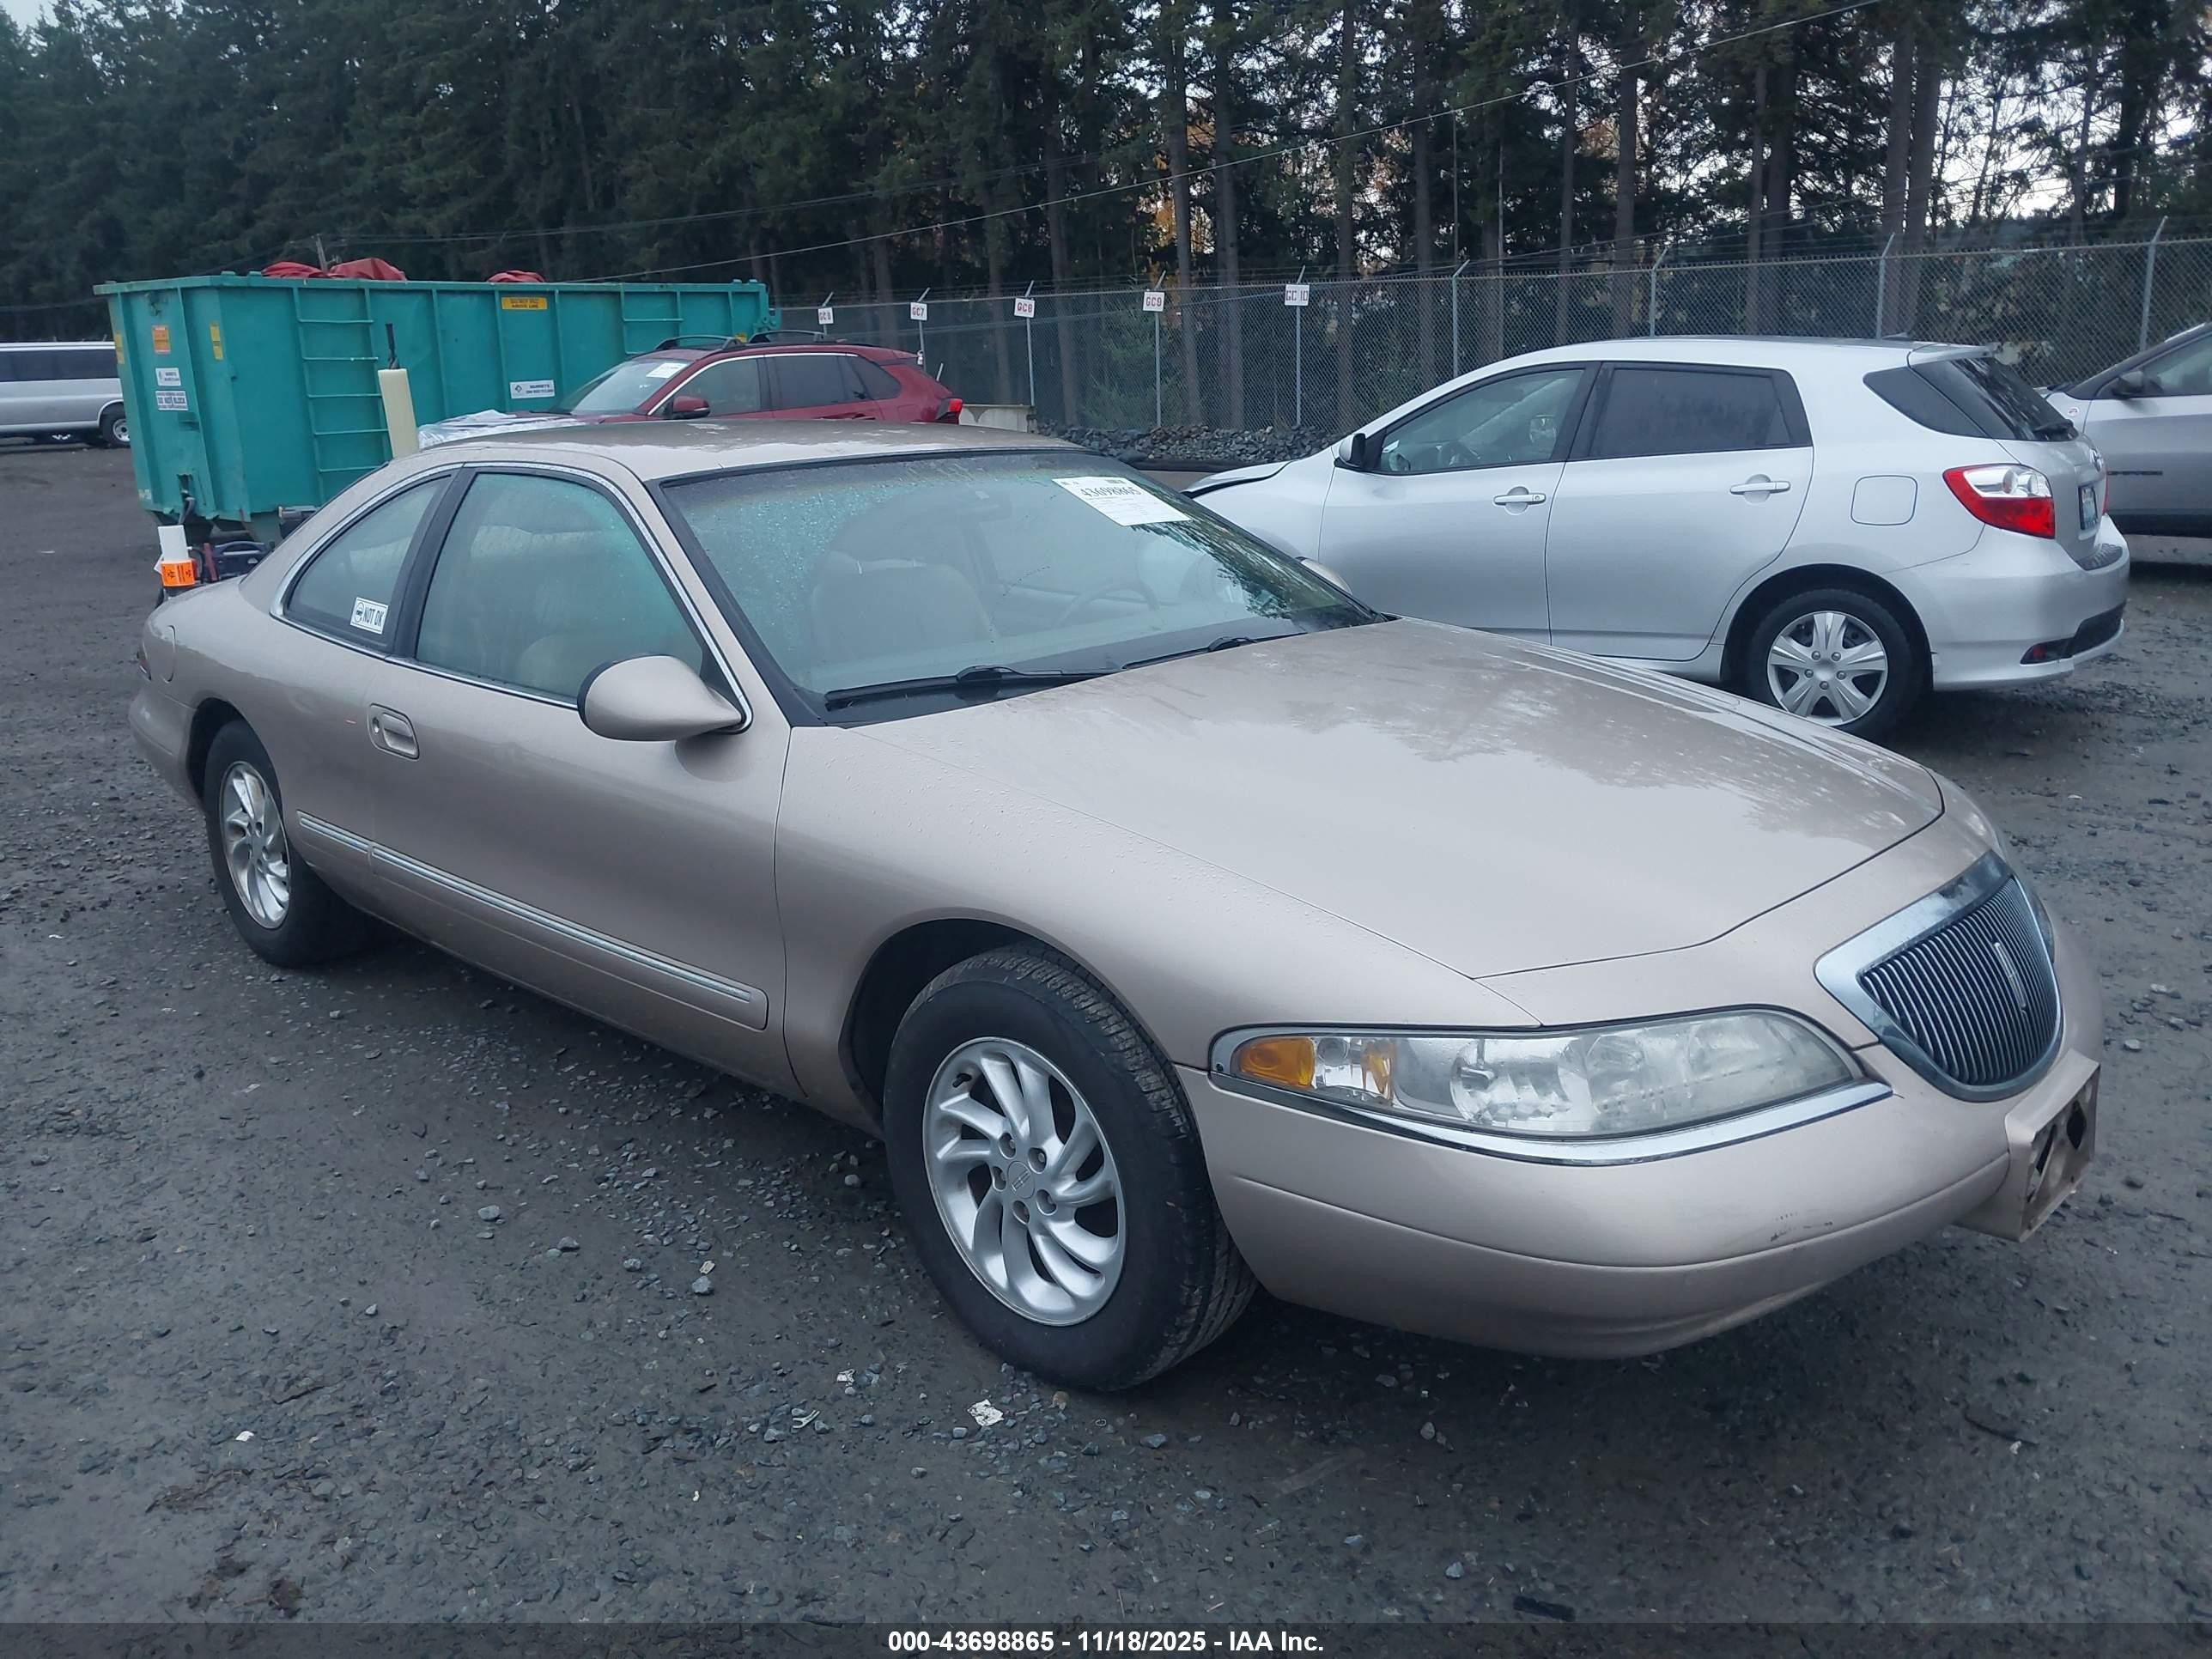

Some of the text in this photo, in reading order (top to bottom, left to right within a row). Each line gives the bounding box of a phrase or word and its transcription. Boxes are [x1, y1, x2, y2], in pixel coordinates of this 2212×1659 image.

[1146, 296, 1162, 307] GC9
[912, 307, 925, 317] GC7
[362, 606, 385, 628] NOT OK
